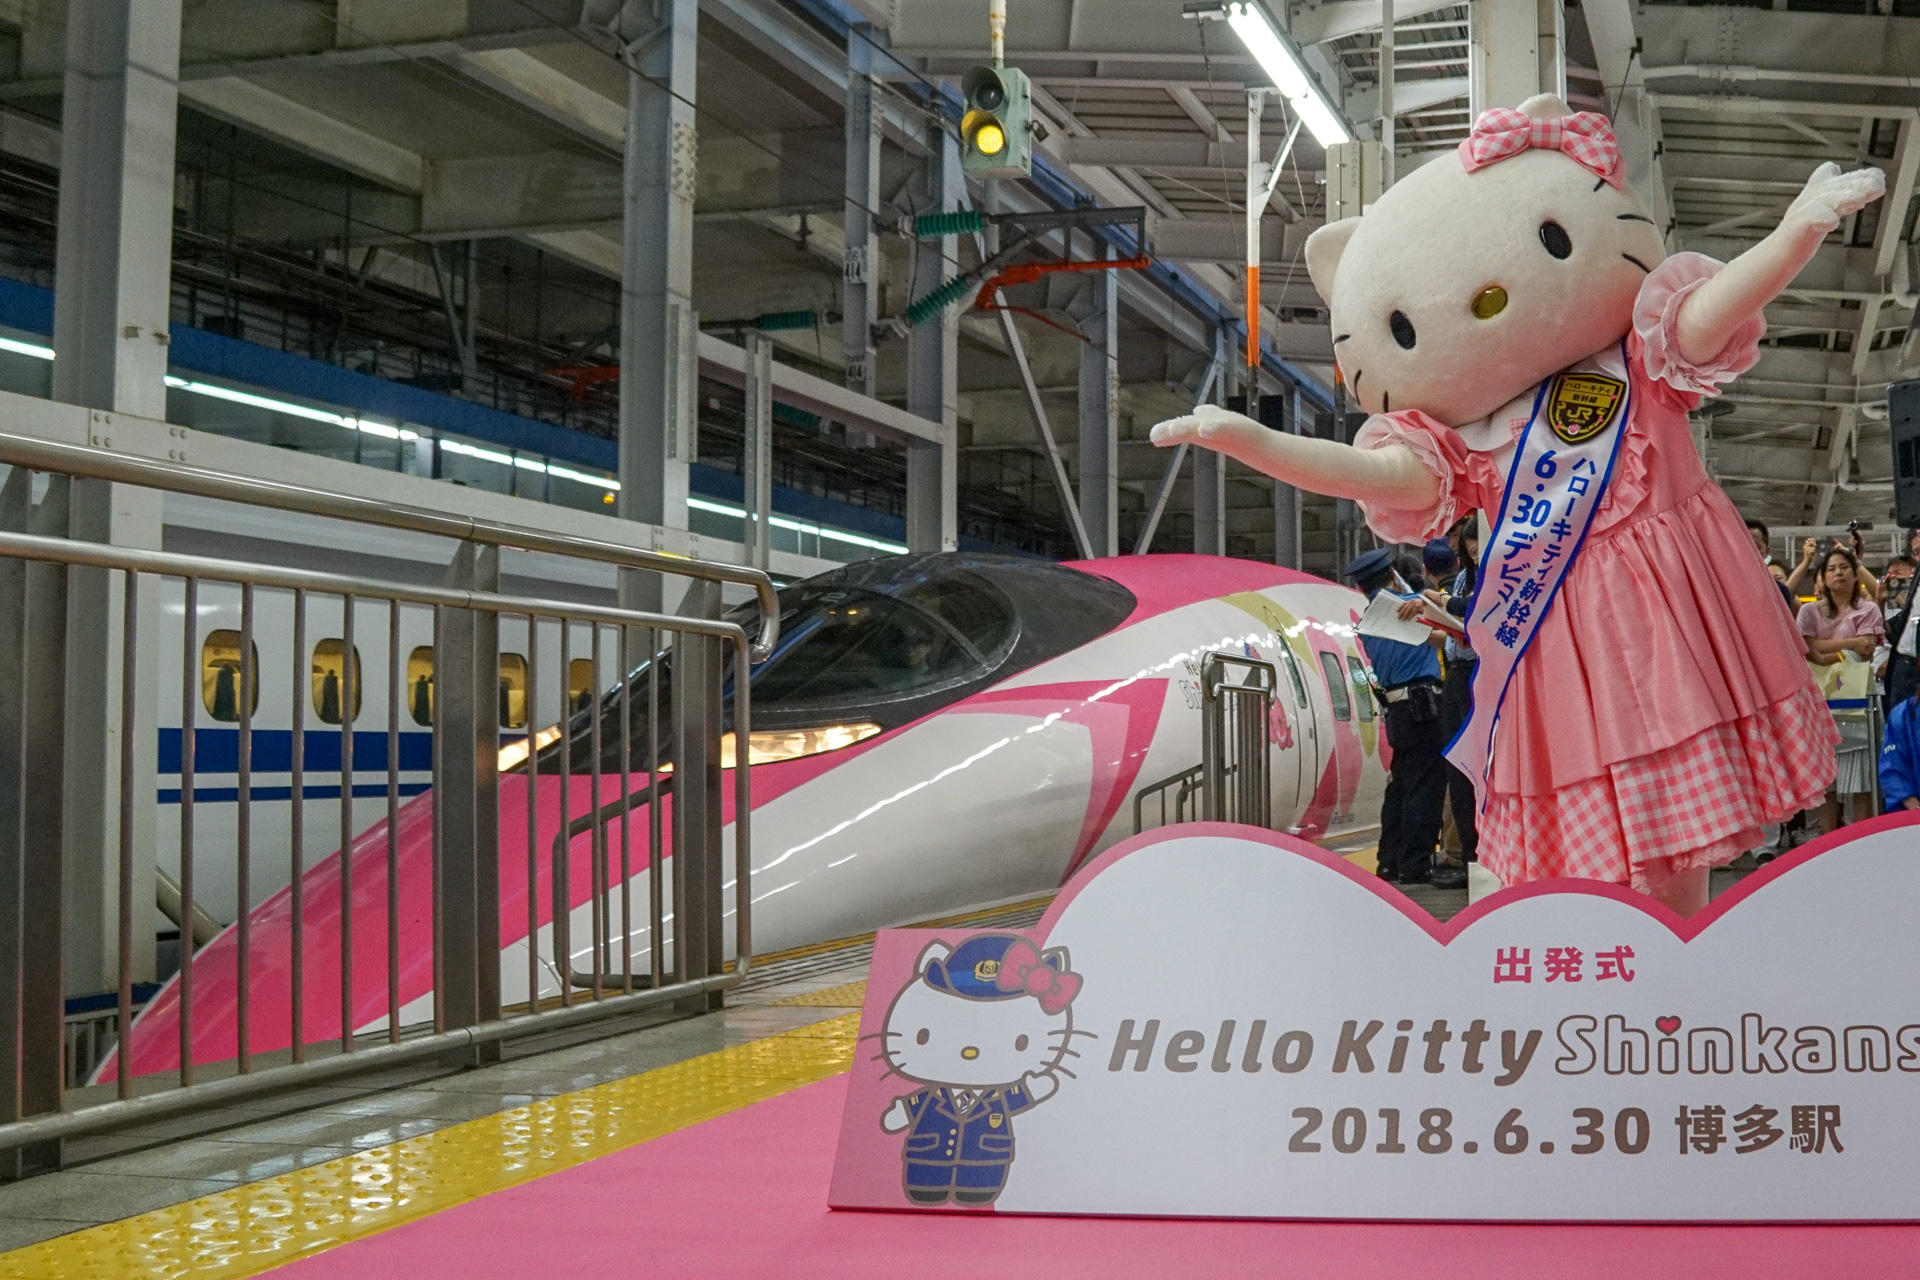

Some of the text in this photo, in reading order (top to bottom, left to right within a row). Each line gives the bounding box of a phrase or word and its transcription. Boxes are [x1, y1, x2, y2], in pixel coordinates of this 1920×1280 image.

[1565, 382, 1611, 394] ハローキティ
[1567, 406, 1592, 420] JR
[1495, 457, 1596, 649] ハローキティ新幹線
[1493, 945, 1635, 983] 出発式
[1108, 1019, 1314, 1074] Hello
[1331, 1019, 1543, 1087] Kitty
[1288, 1104, 1845, 1155] 2018.6.30 博多駅
